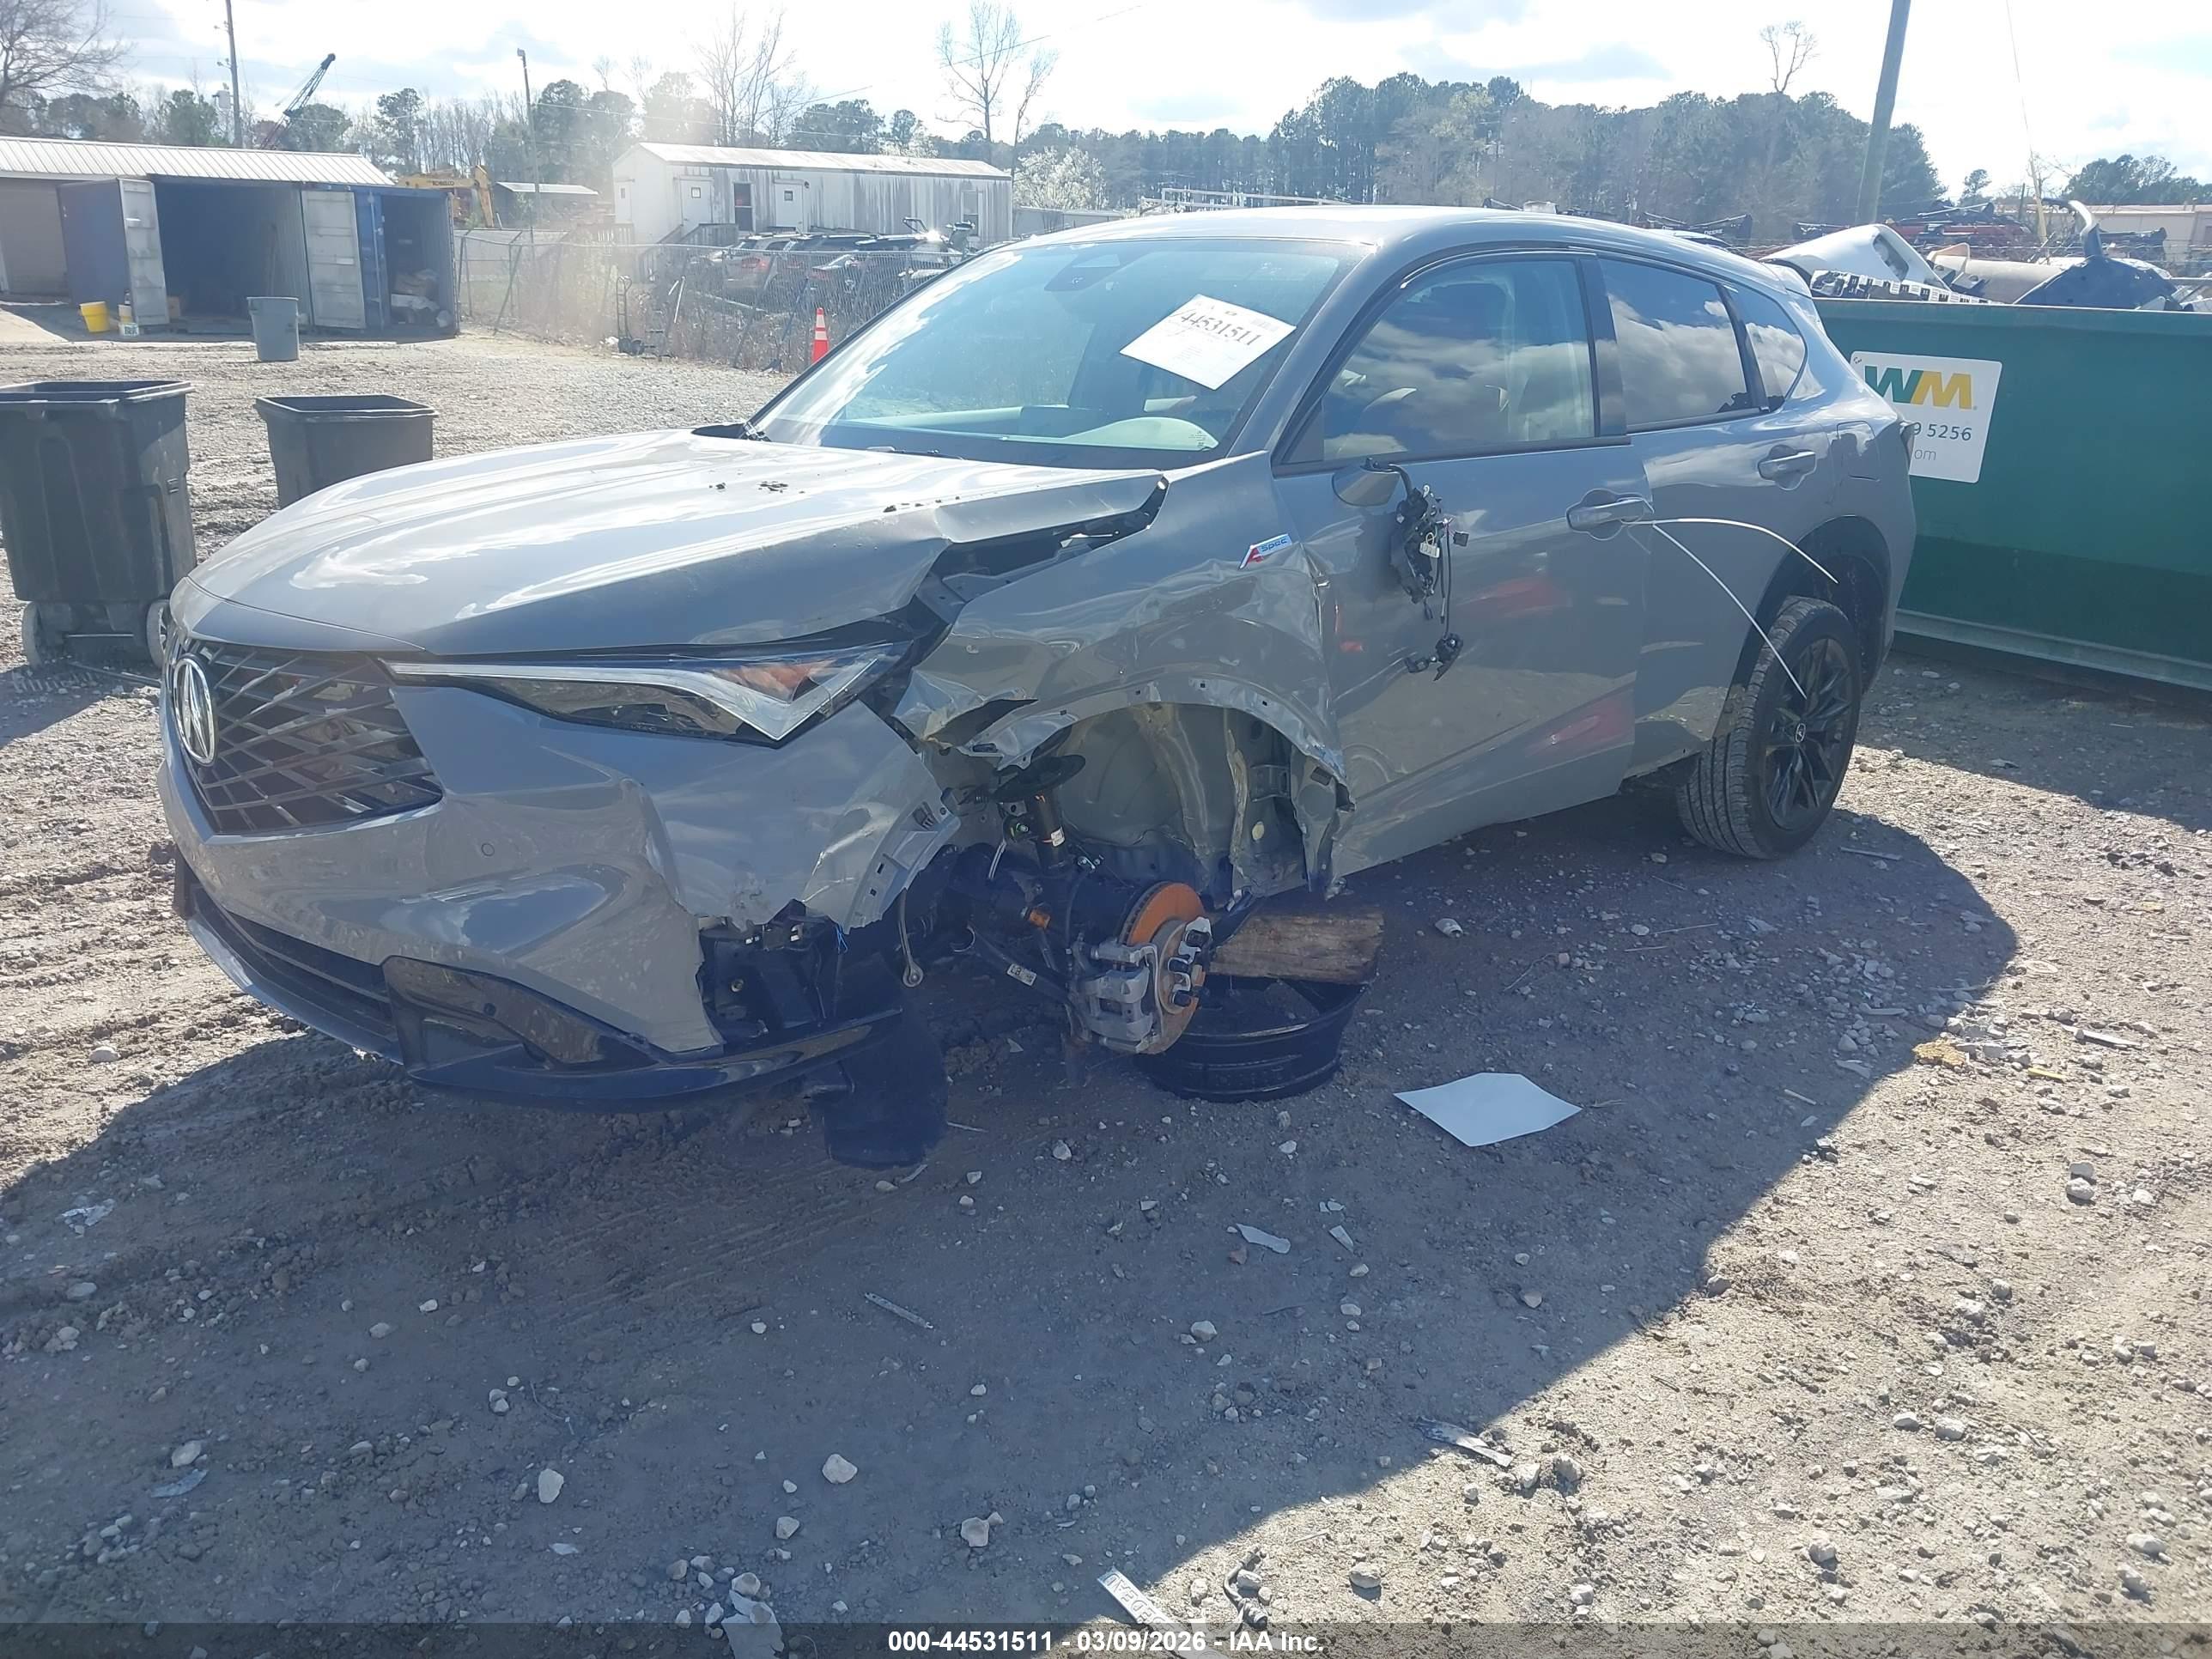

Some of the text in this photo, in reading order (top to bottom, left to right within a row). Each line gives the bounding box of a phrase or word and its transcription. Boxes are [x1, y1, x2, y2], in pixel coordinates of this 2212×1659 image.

[1181, 313, 1261, 345] 44531511
[1864, 366, 1972, 410] WM
[1926, 423, 1972, 441] 5256
